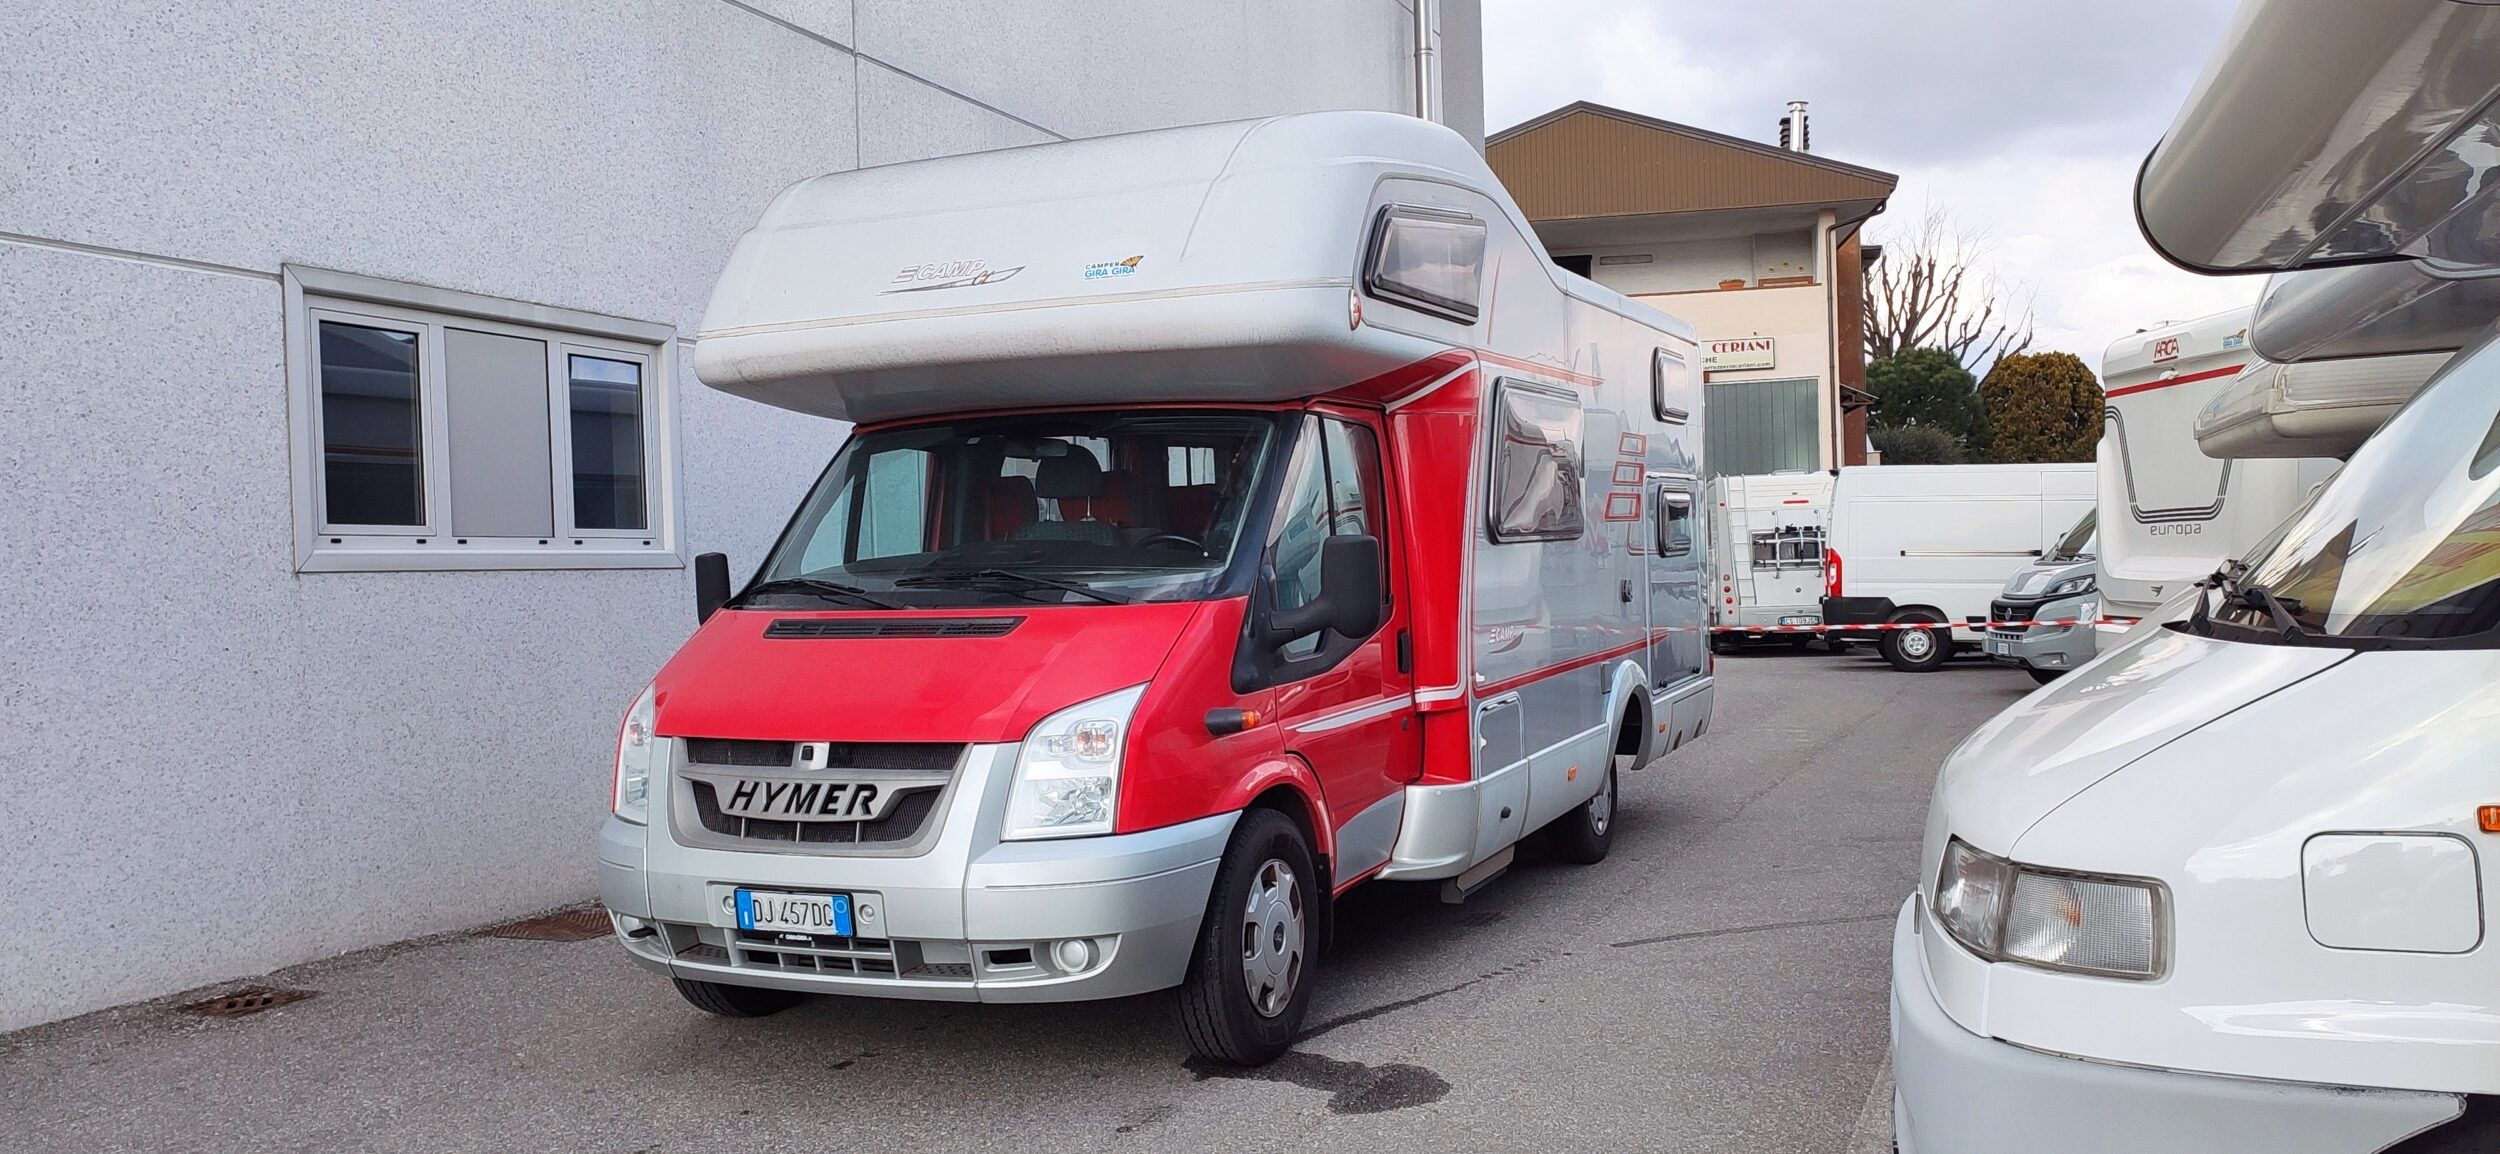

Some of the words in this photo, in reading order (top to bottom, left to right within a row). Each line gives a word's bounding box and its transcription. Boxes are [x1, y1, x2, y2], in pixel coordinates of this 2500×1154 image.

[1085, 269, 1108, 277] GIRA
[1111, 267, 1135, 275] GIRA
[1712, 340, 1770, 353] CERIANI
[2154, 338, 2179, 358] ARCA
[2150, 523, 2202, 536] europa
[728, 780, 878, 815] HYMER
[753, 900, 773, 923] DJ
